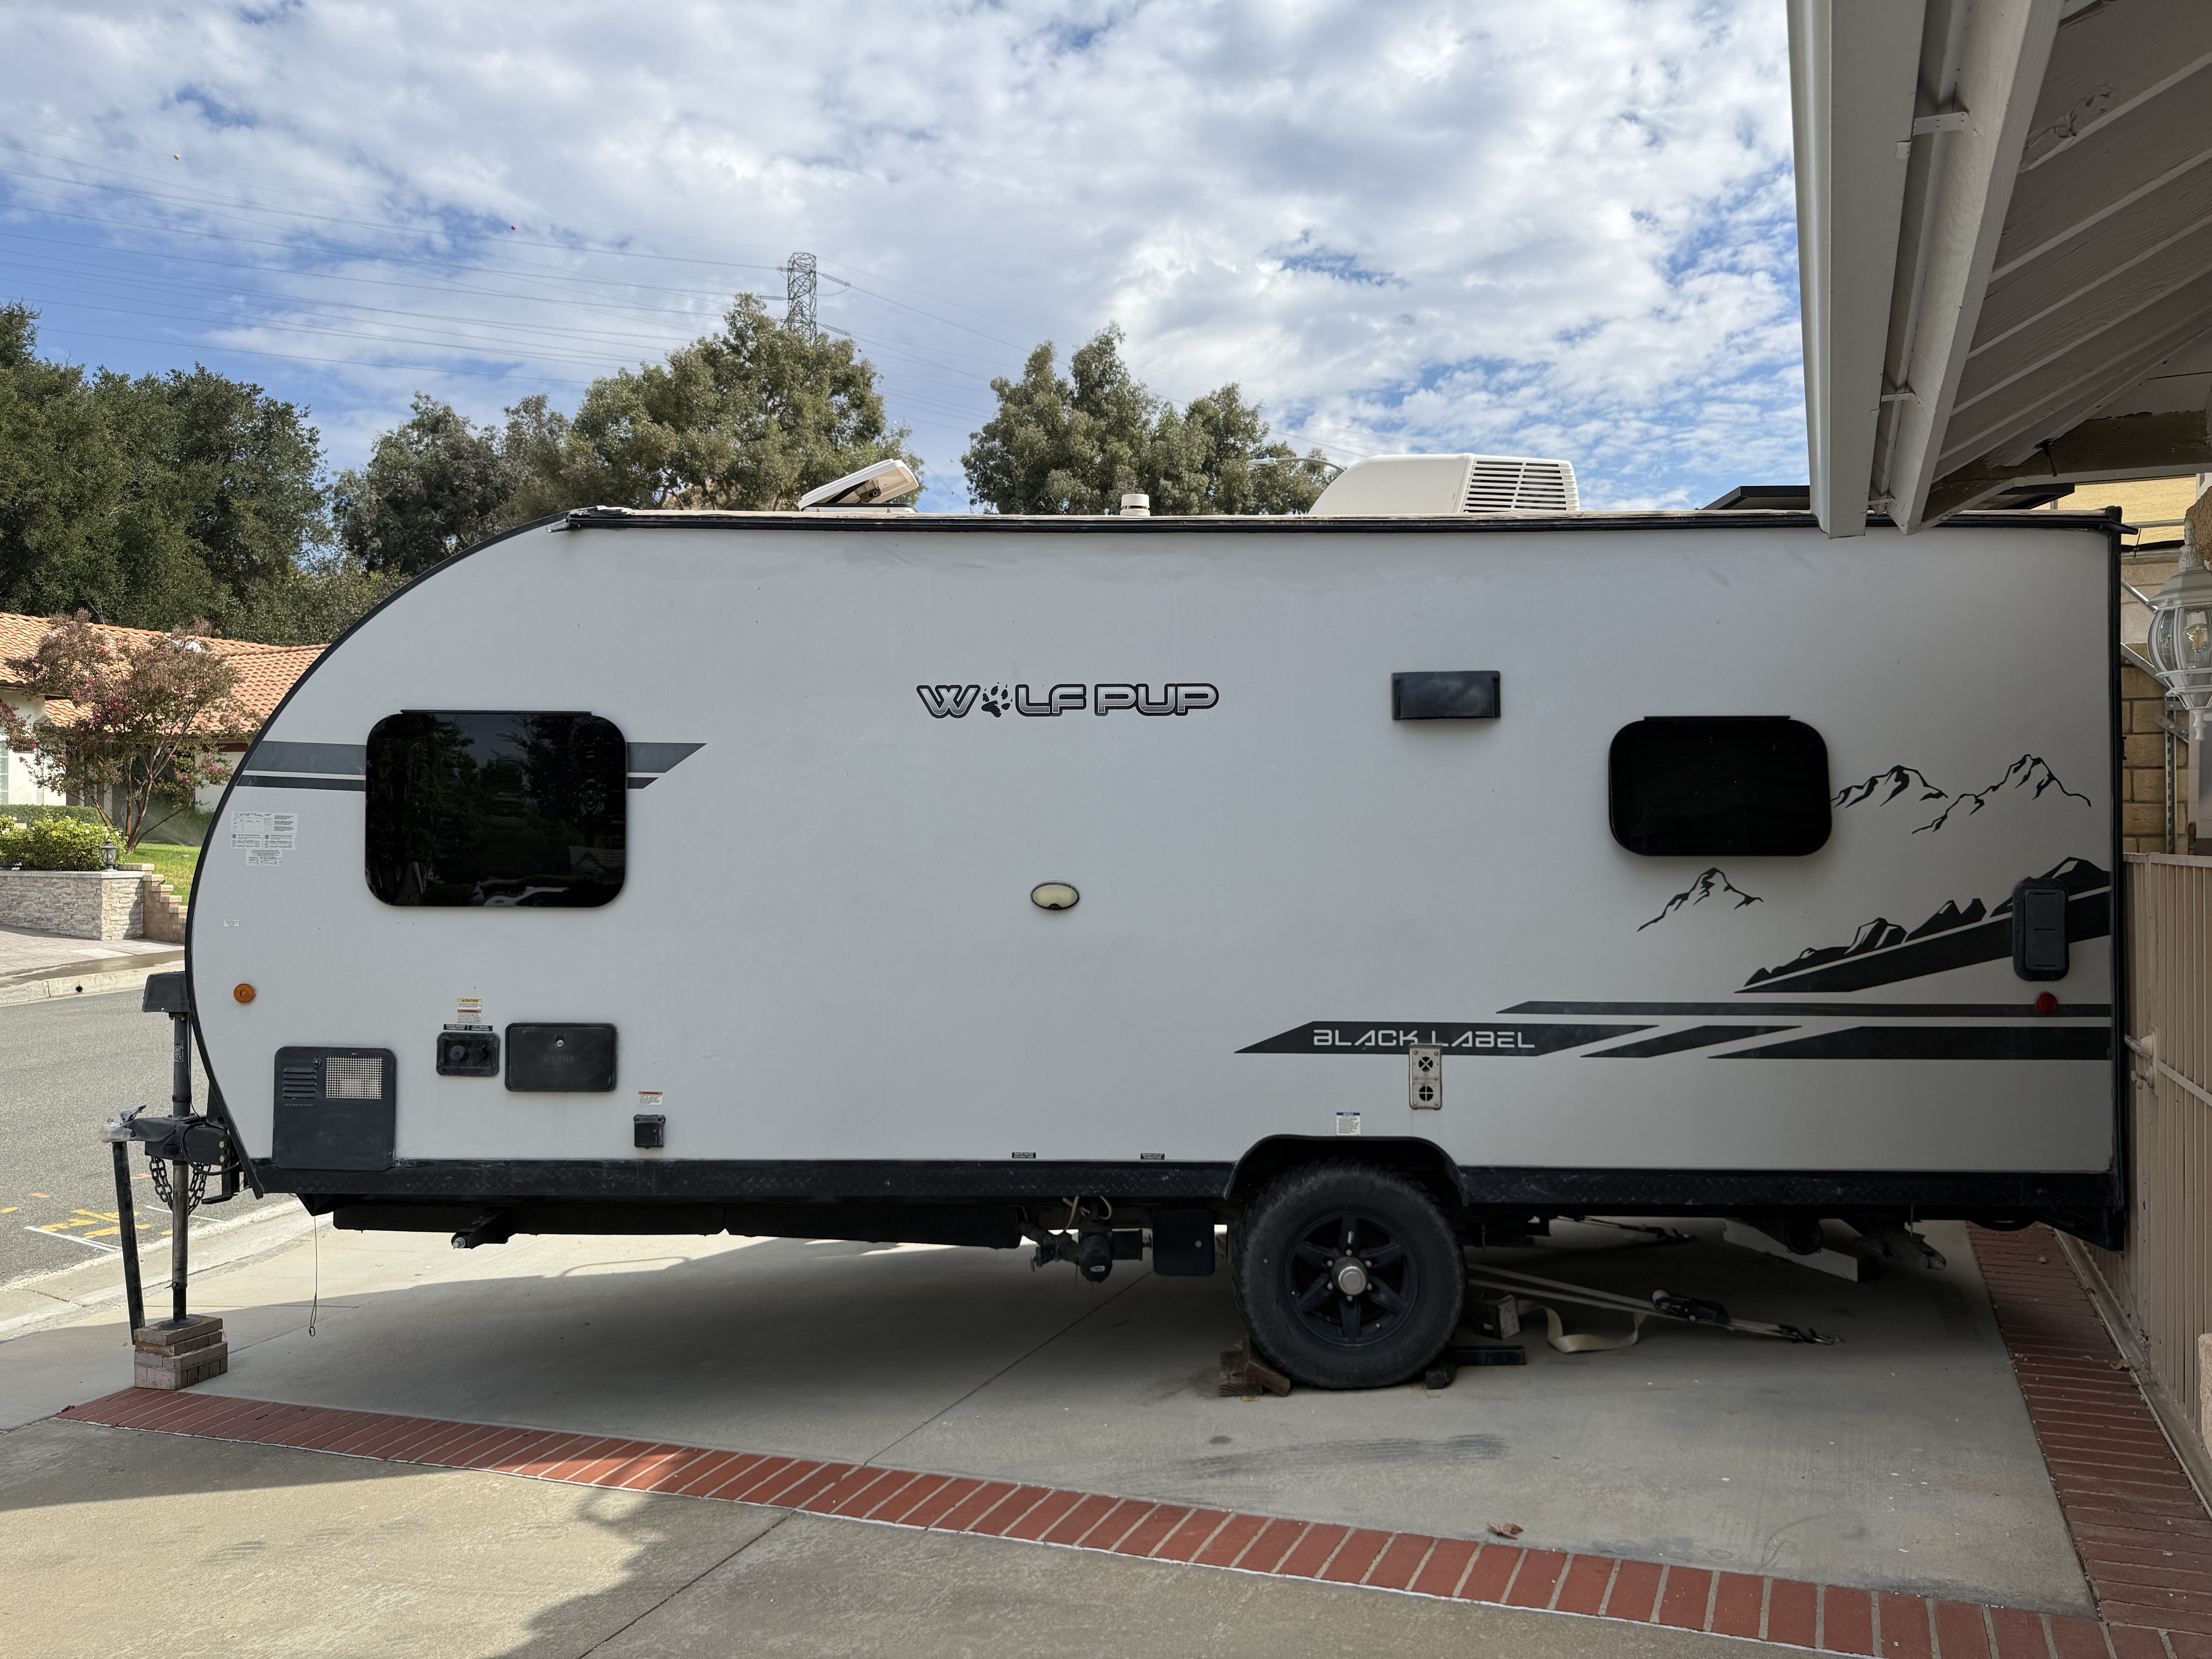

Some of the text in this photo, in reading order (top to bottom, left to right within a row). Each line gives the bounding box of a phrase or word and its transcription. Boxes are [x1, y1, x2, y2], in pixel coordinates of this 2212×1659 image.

[1095, 683, 1219, 716] PUP
[1314, 1030, 1535, 1048] BLACK LABEL
